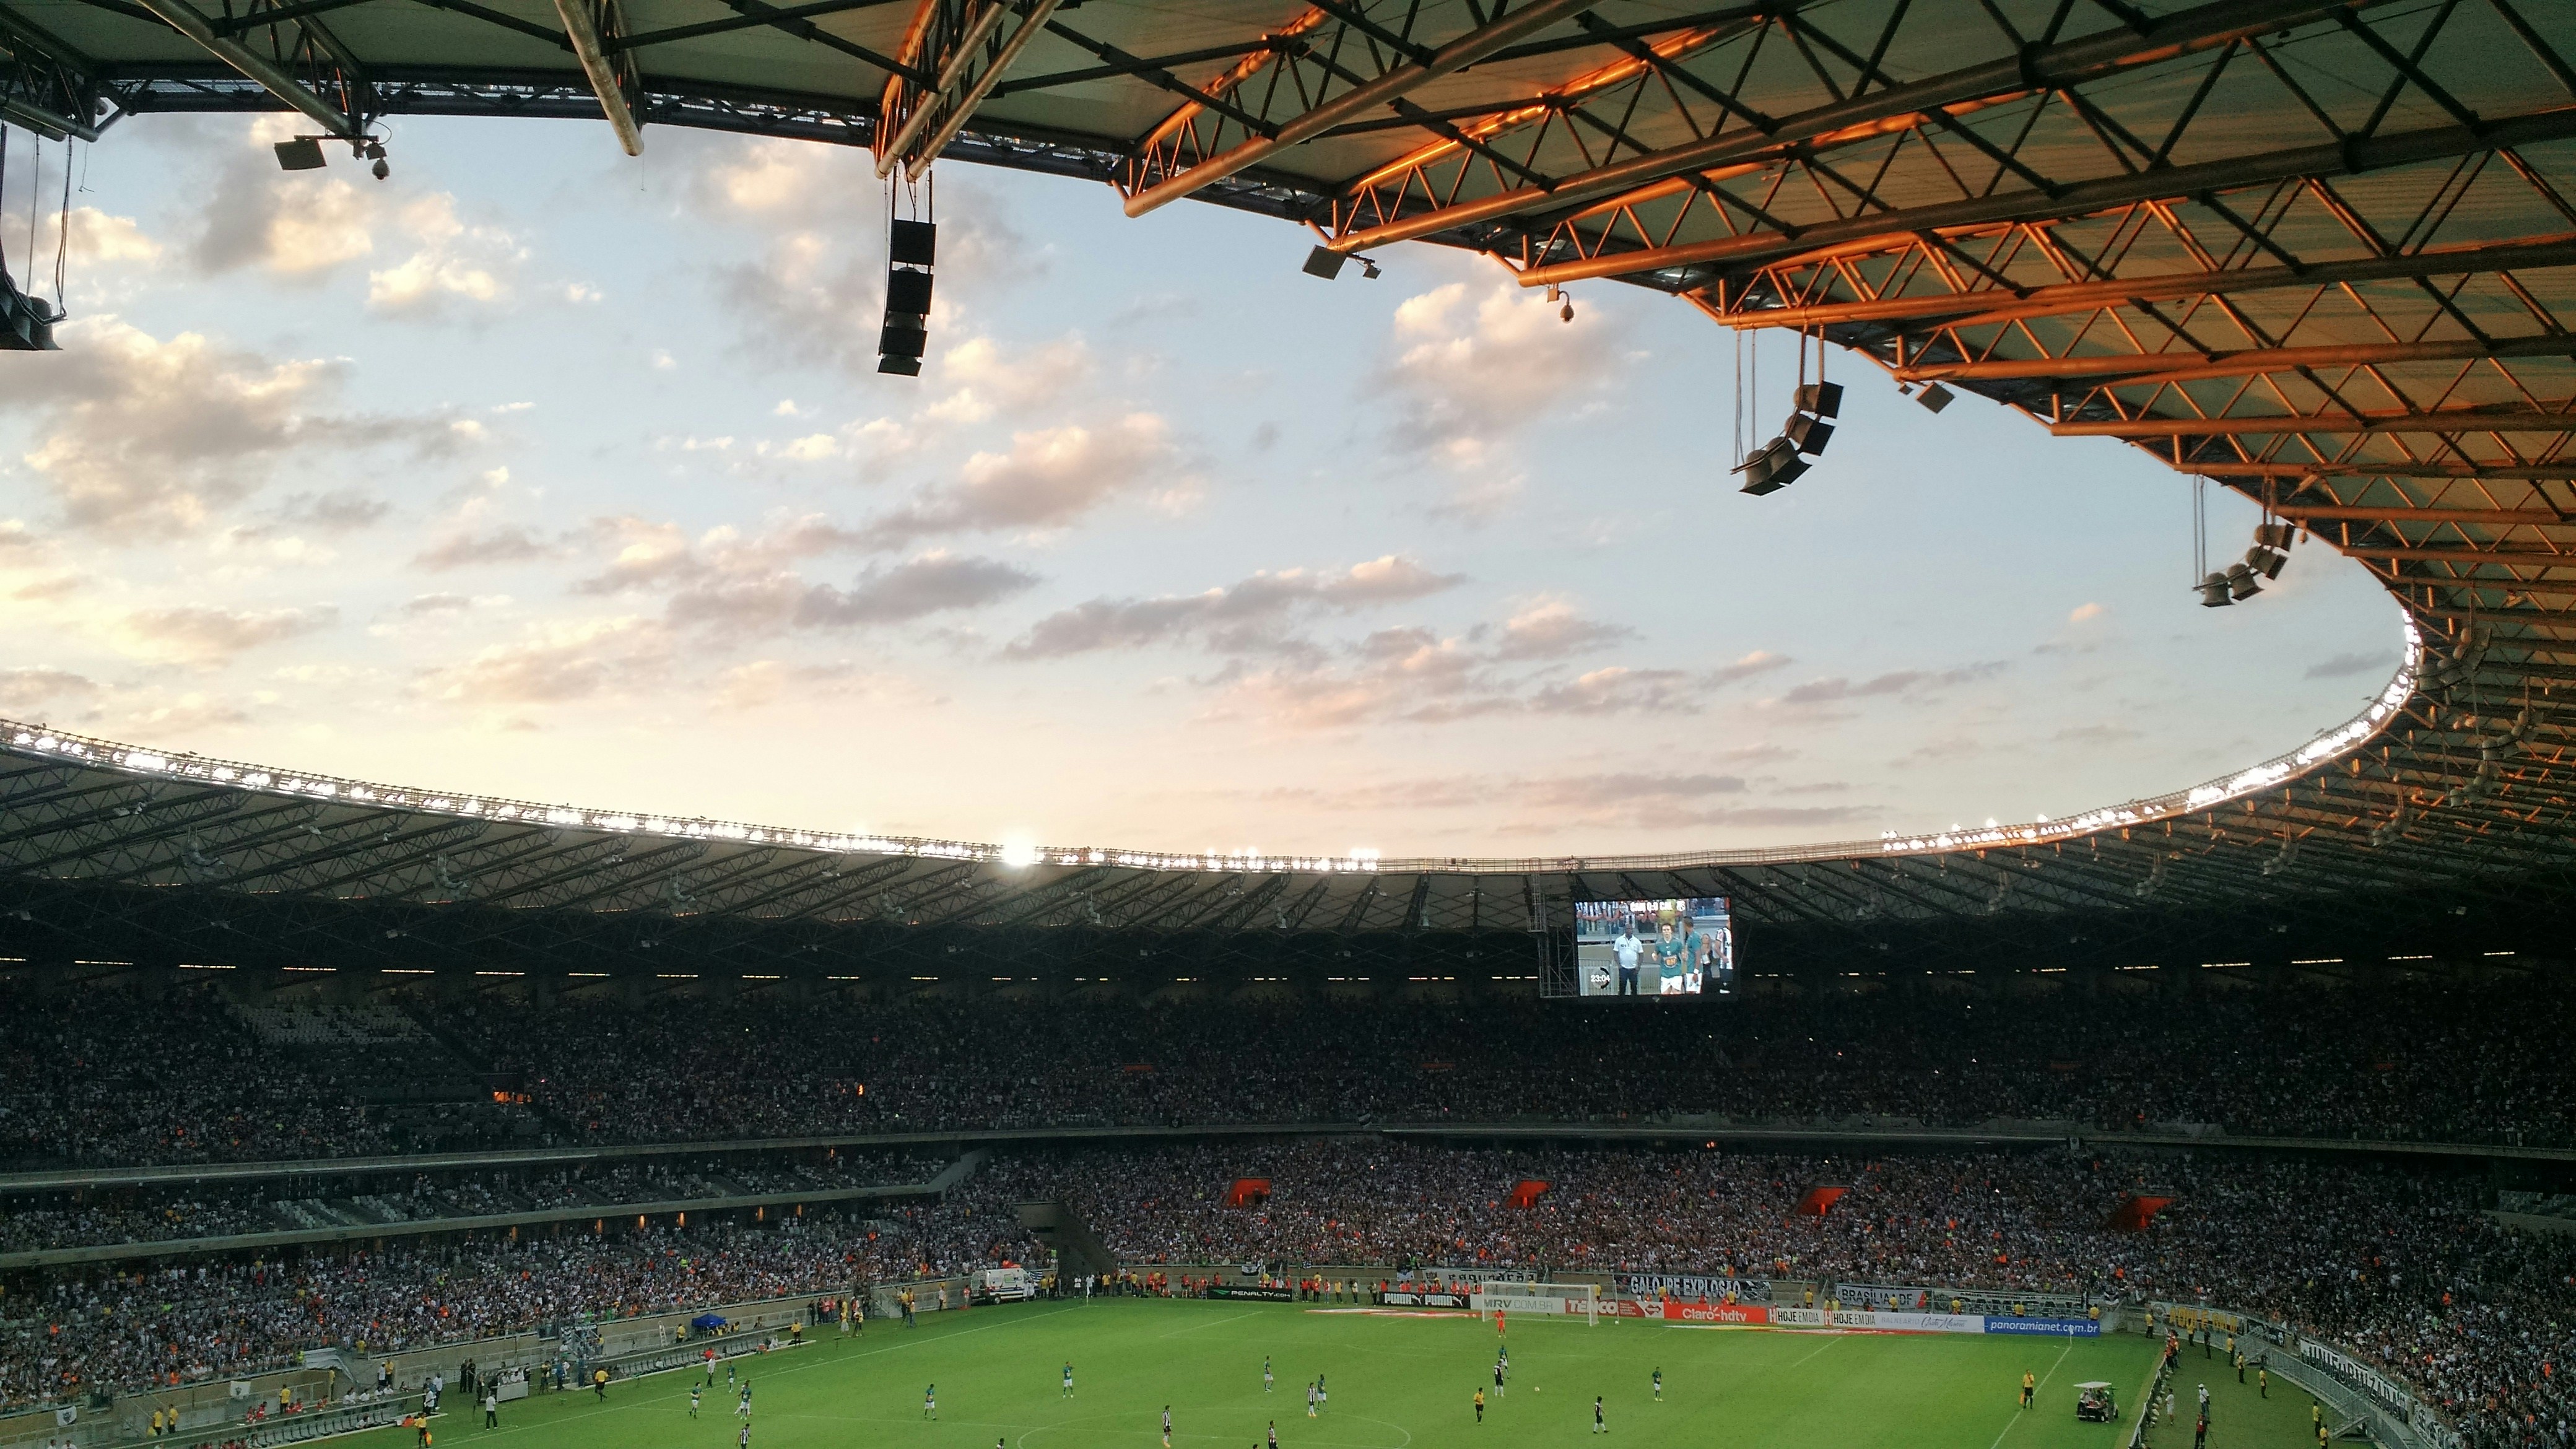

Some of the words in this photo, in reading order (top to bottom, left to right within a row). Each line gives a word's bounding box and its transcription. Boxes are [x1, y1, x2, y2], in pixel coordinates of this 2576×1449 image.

[1590, 974, 1611, 982] 23:04
[1630, 1276, 1660, 1295] GALO
[1231, 1290, 1290, 1298] PENALTY.COM
[1384, 1294, 1412, 1305] PUMA
[1425, 1294, 1453, 1306] PUMA
[1899, 1294, 1913, 1305] DF
[1484, 1299, 1512, 1308] MRV
[1569, 1299, 1618, 1315] TENCO
[1778, 1310, 1796, 1322] HOJE
[1798, 1311, 1808, 1323] EM
[1809, 1312, 1819, 1323] DIA
[1834, 1313, 1853, 1325] HOJE
[1855, 1313, 1865, 1325] EM
[1865, 1314, 1876, 1325] DIA
[1990, 1321, 2099, 1333] panoramianet.com.br
